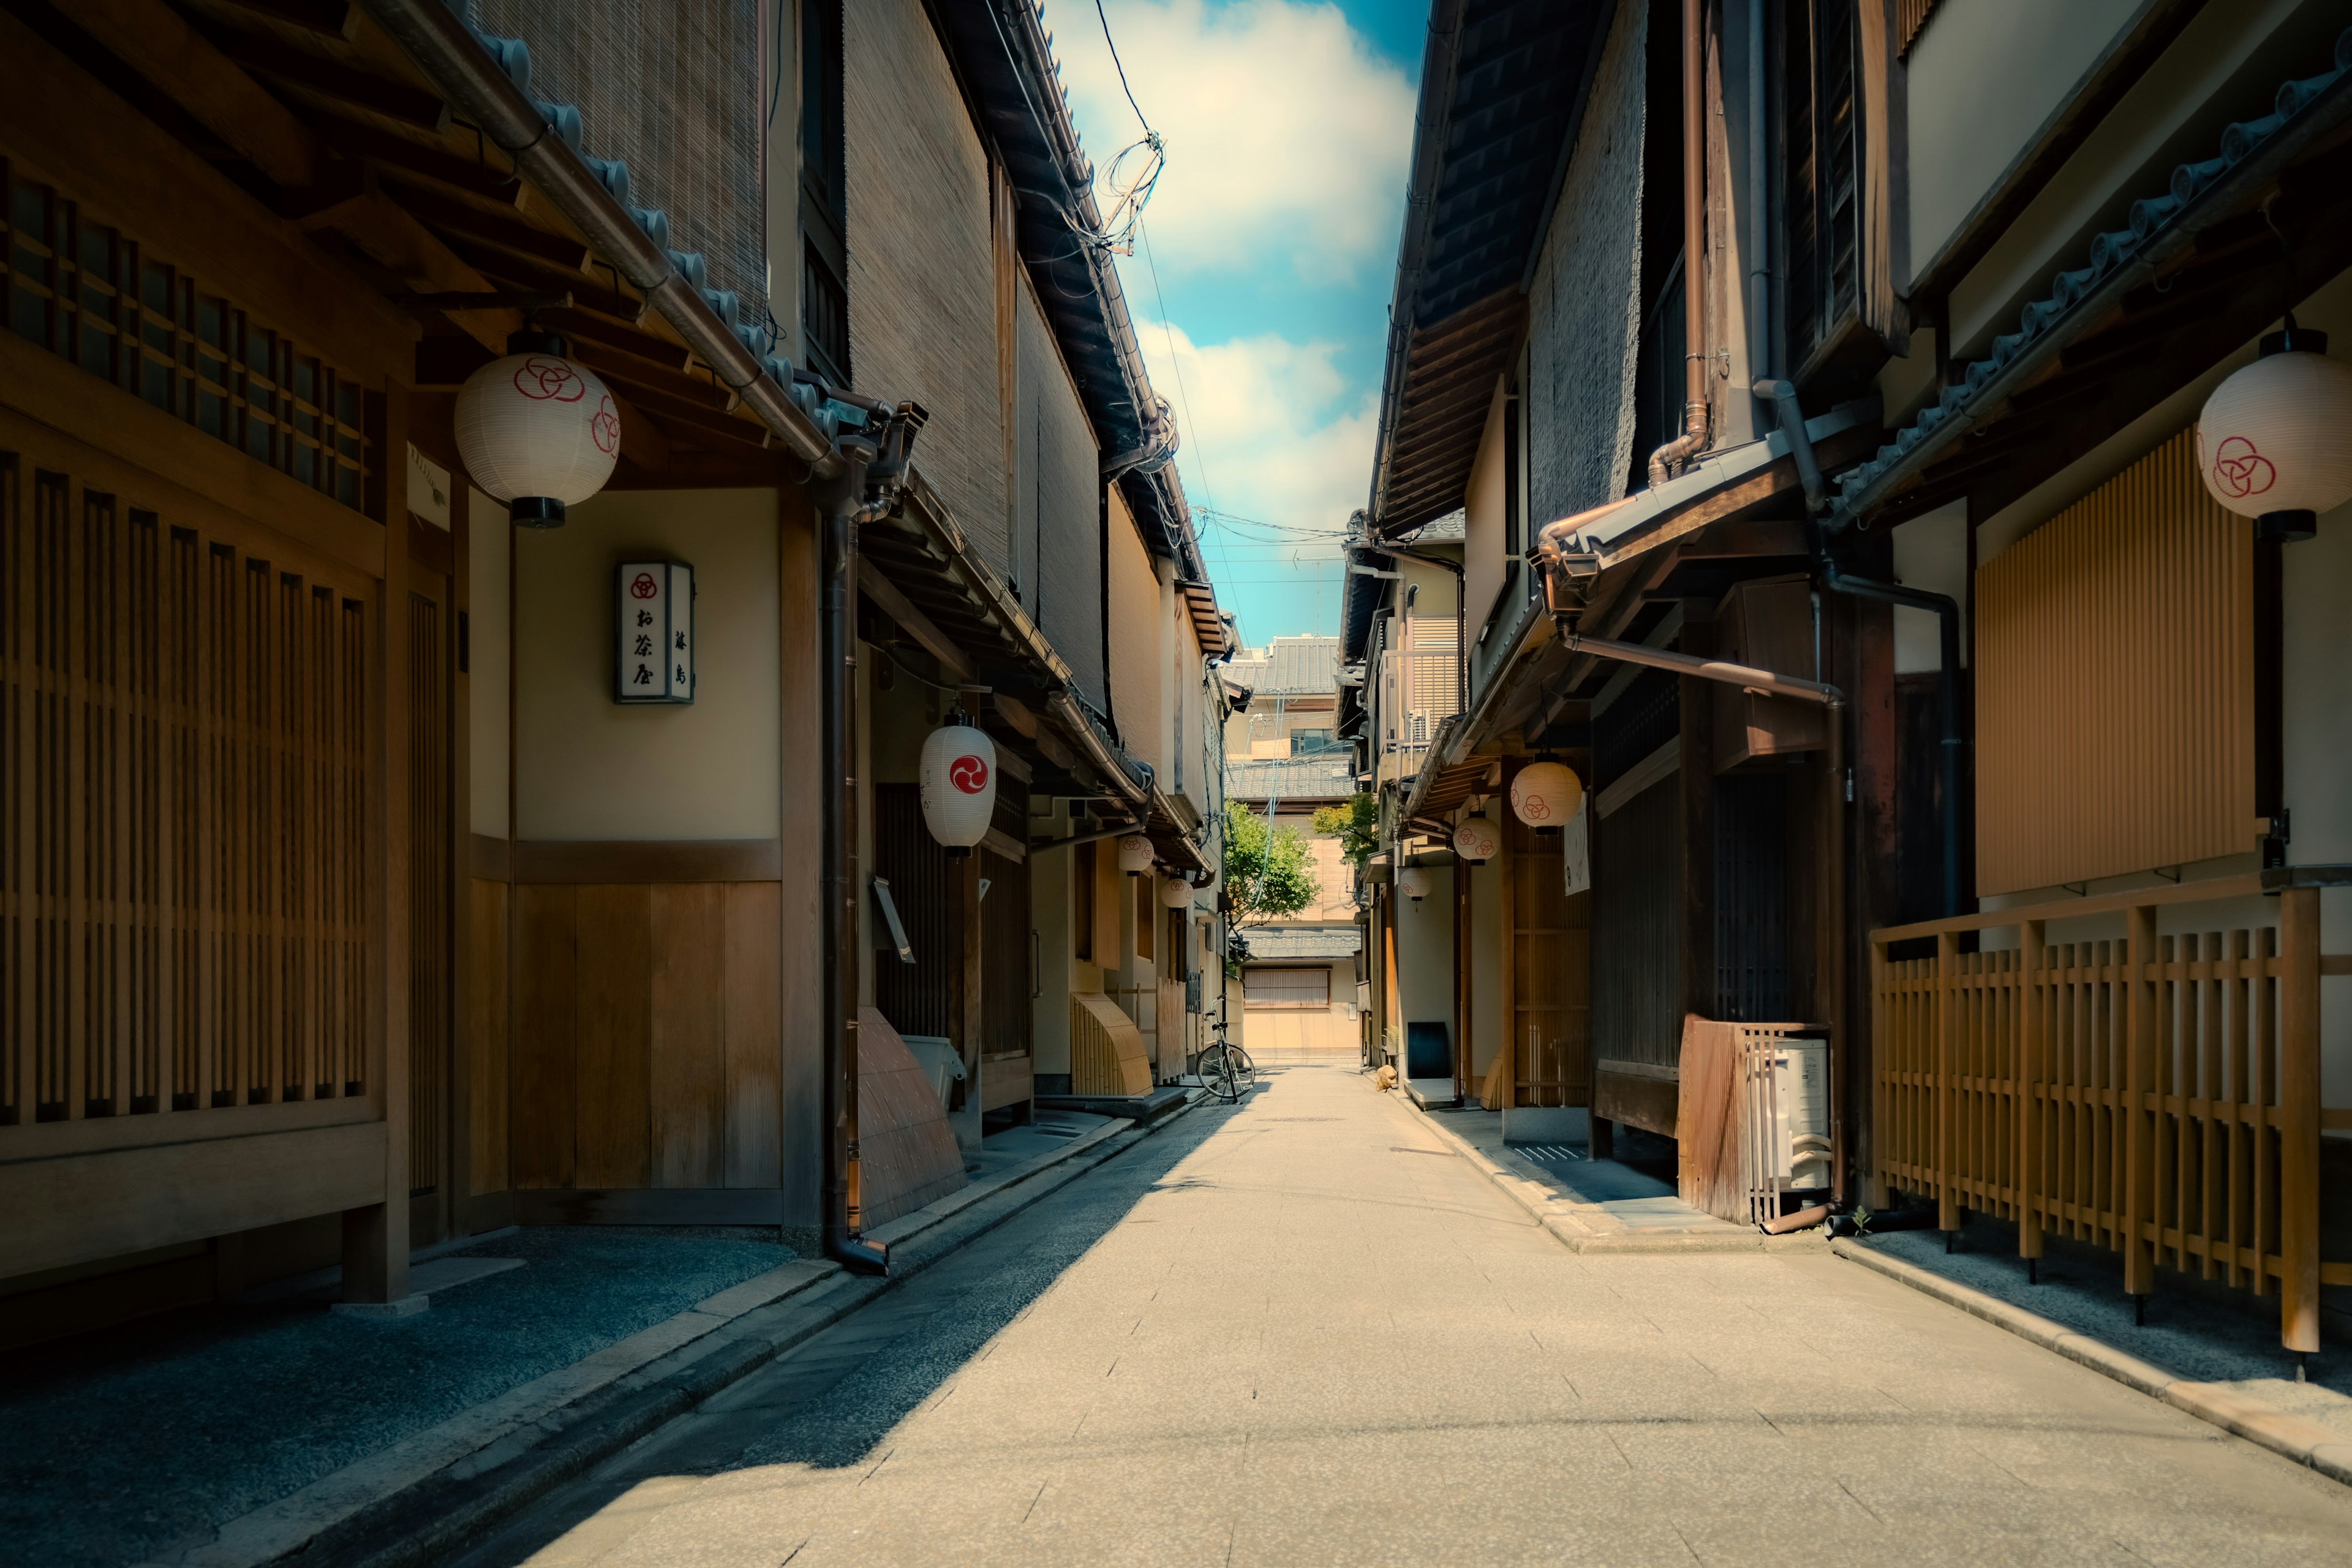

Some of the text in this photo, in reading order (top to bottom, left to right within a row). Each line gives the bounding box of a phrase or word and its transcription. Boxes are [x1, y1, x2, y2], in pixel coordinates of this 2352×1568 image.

[634, 609, 654, 685] お茶屋
[675, 630, 687, 685] 藤島
